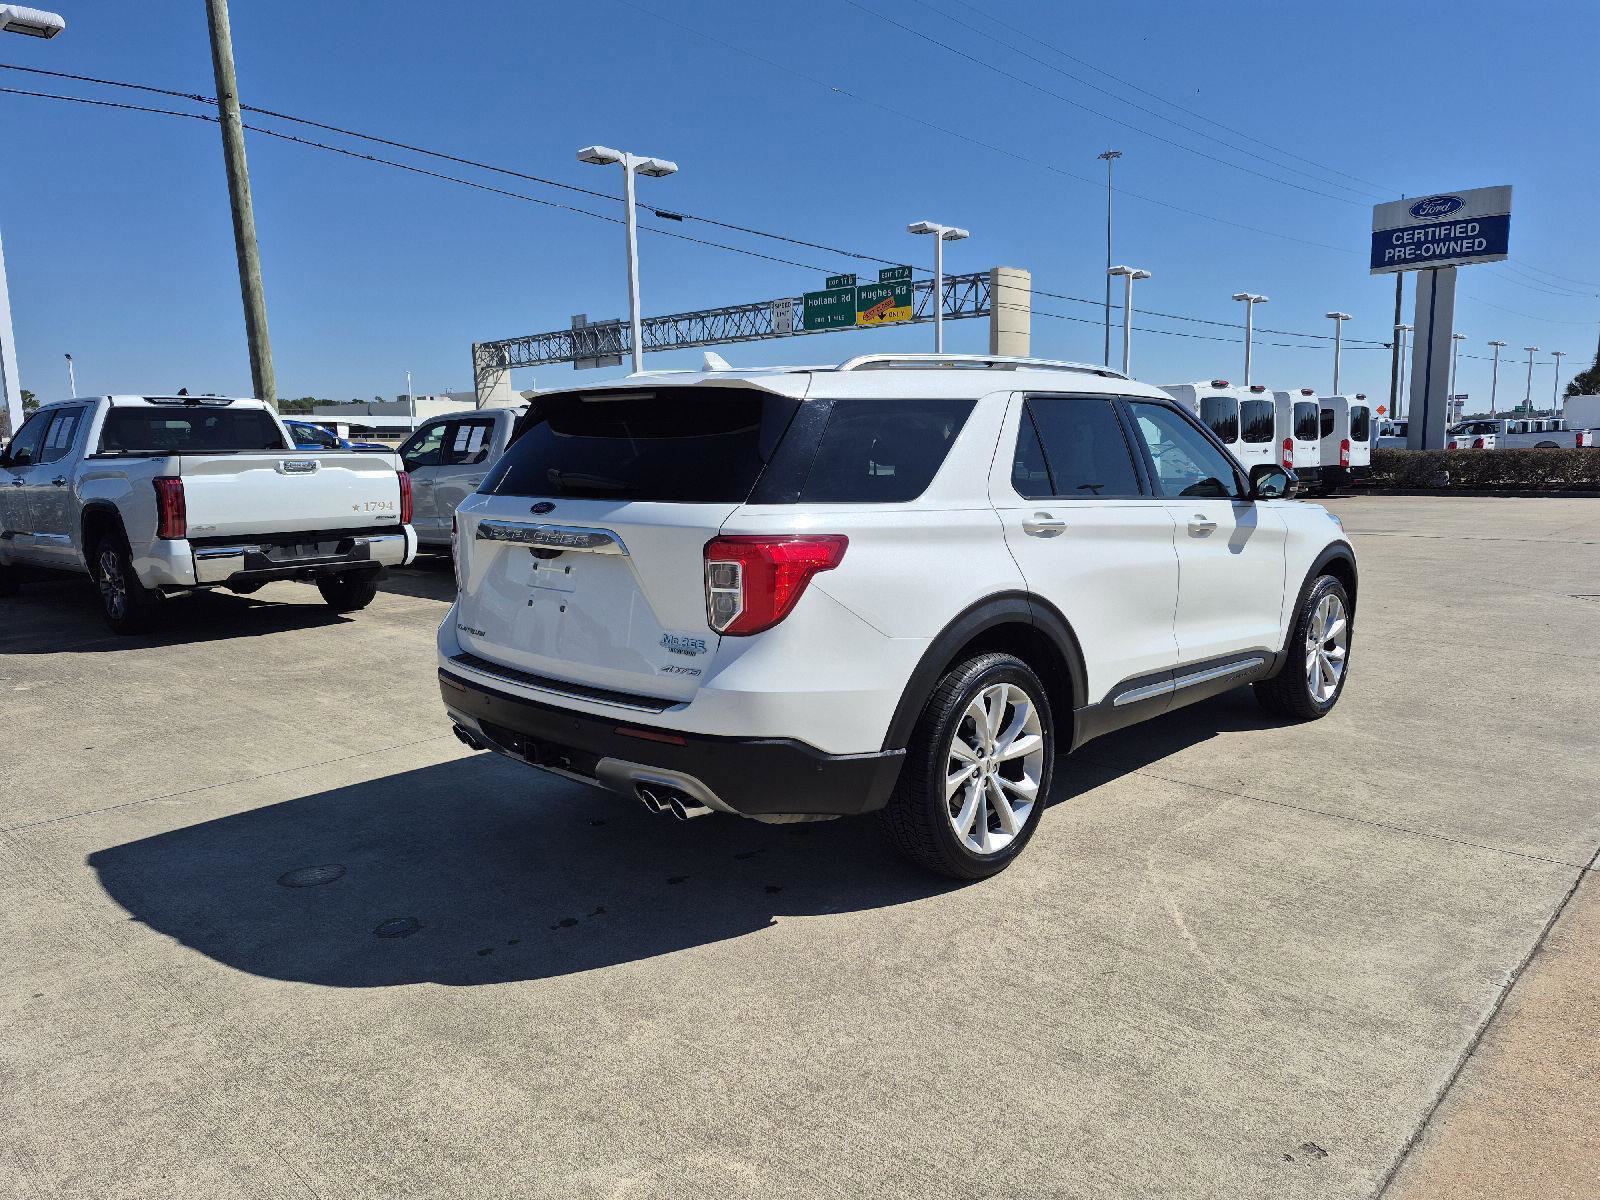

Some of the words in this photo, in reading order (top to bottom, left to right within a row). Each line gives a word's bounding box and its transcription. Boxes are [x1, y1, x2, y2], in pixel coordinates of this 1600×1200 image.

[1419, 199, 1450, 215] Ford
[1391, 222, 1480, 245] CERTIFIED
[1384, 237, 1487, 262] PRE-OWNED
[808, 294, 838, 306] Holland
[841, 293, 851, 304] Rd
[861, 288, 892, 300] Hughes
[895, 285, 908, 295] Rd
[363, 501, 395, 512] 1794
[489, 527, 591, 547] EXPLORER
